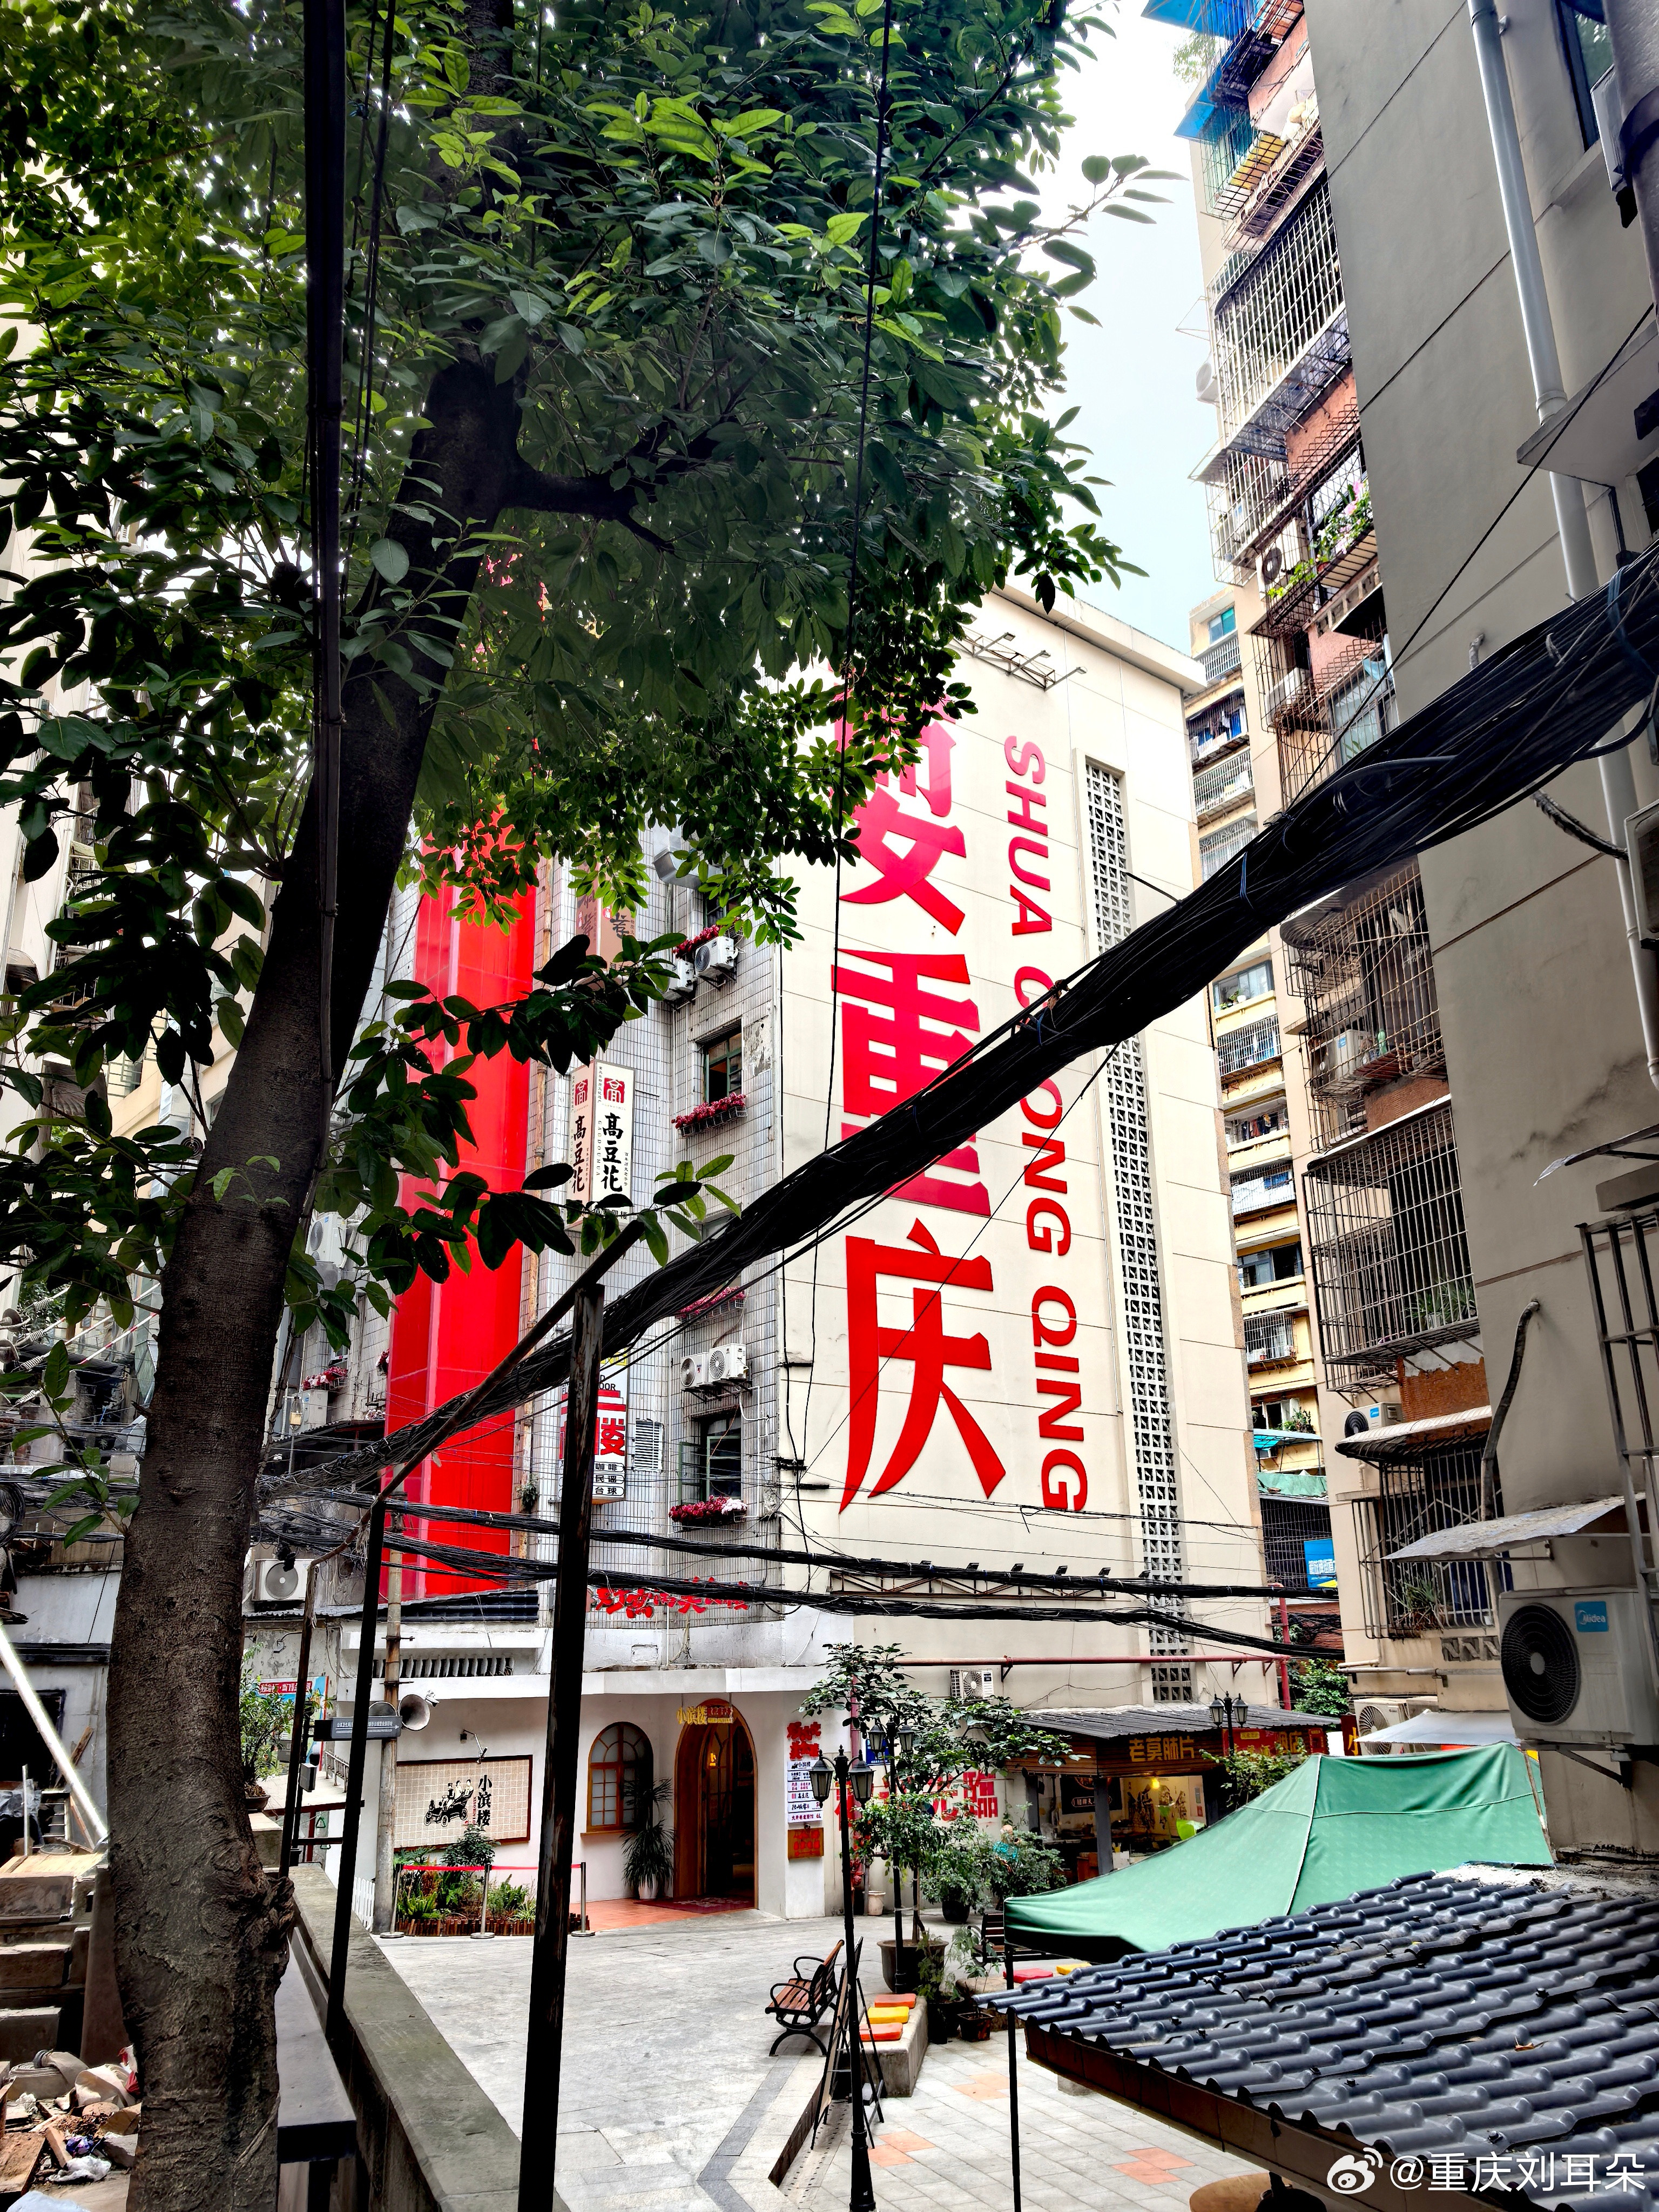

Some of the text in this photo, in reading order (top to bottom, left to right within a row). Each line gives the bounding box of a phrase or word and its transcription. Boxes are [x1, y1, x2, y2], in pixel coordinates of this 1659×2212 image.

[1004, 736, 1088, 1512] SHUA CONG QING
[572, 1116, 586, 1193] 高豆花
[601, 1112, 624, 1192] 高豆花
[596, 1463, 617, 1471] 咖啡
[596, 1475, 617, 1483] 民谣
[1579, 1611, 1606, 1623] Midea
[1129, 1736, 1195, 1762] 老莫肺片
[477, 1775, 492, 1826] 小滨楼
